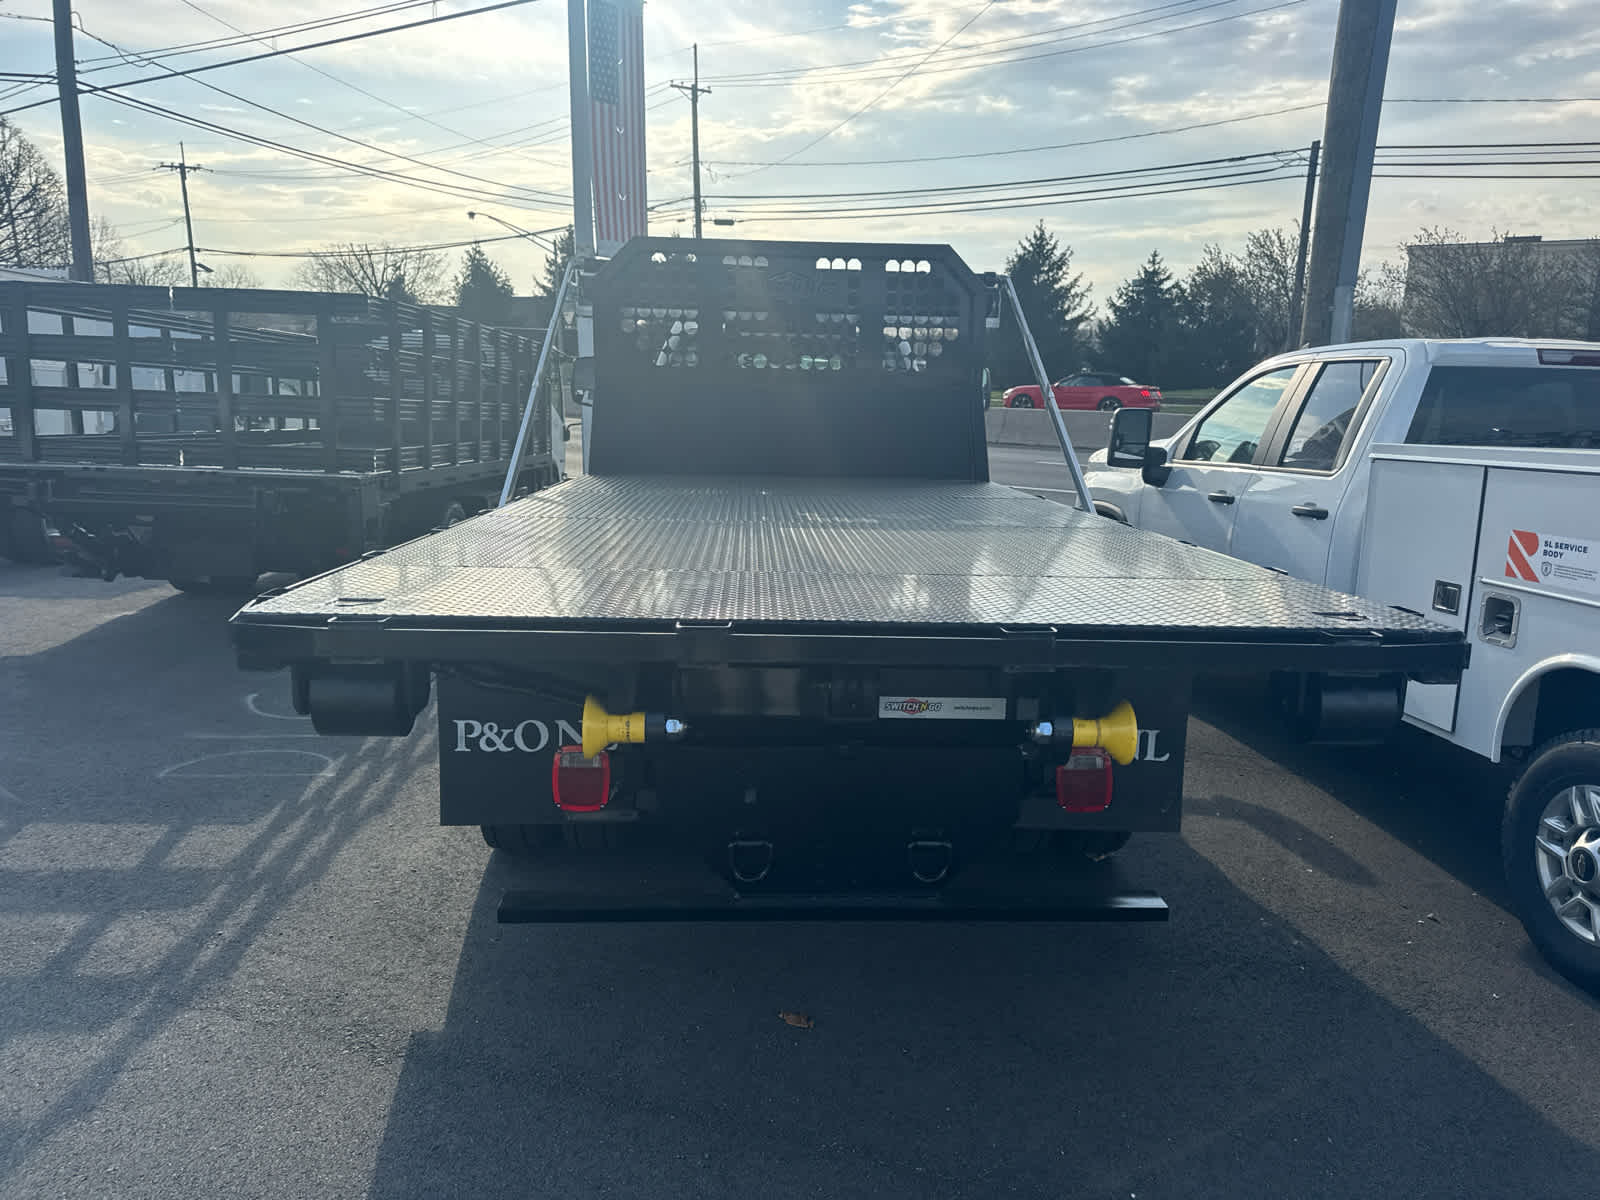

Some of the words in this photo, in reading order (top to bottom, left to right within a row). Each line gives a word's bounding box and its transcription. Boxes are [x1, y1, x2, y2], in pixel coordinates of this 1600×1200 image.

[1544, 540, 1552, 548] SL
[1554, 542, 1588, 553] SERVICE
[1543, 549, 1564, 559] BODY
